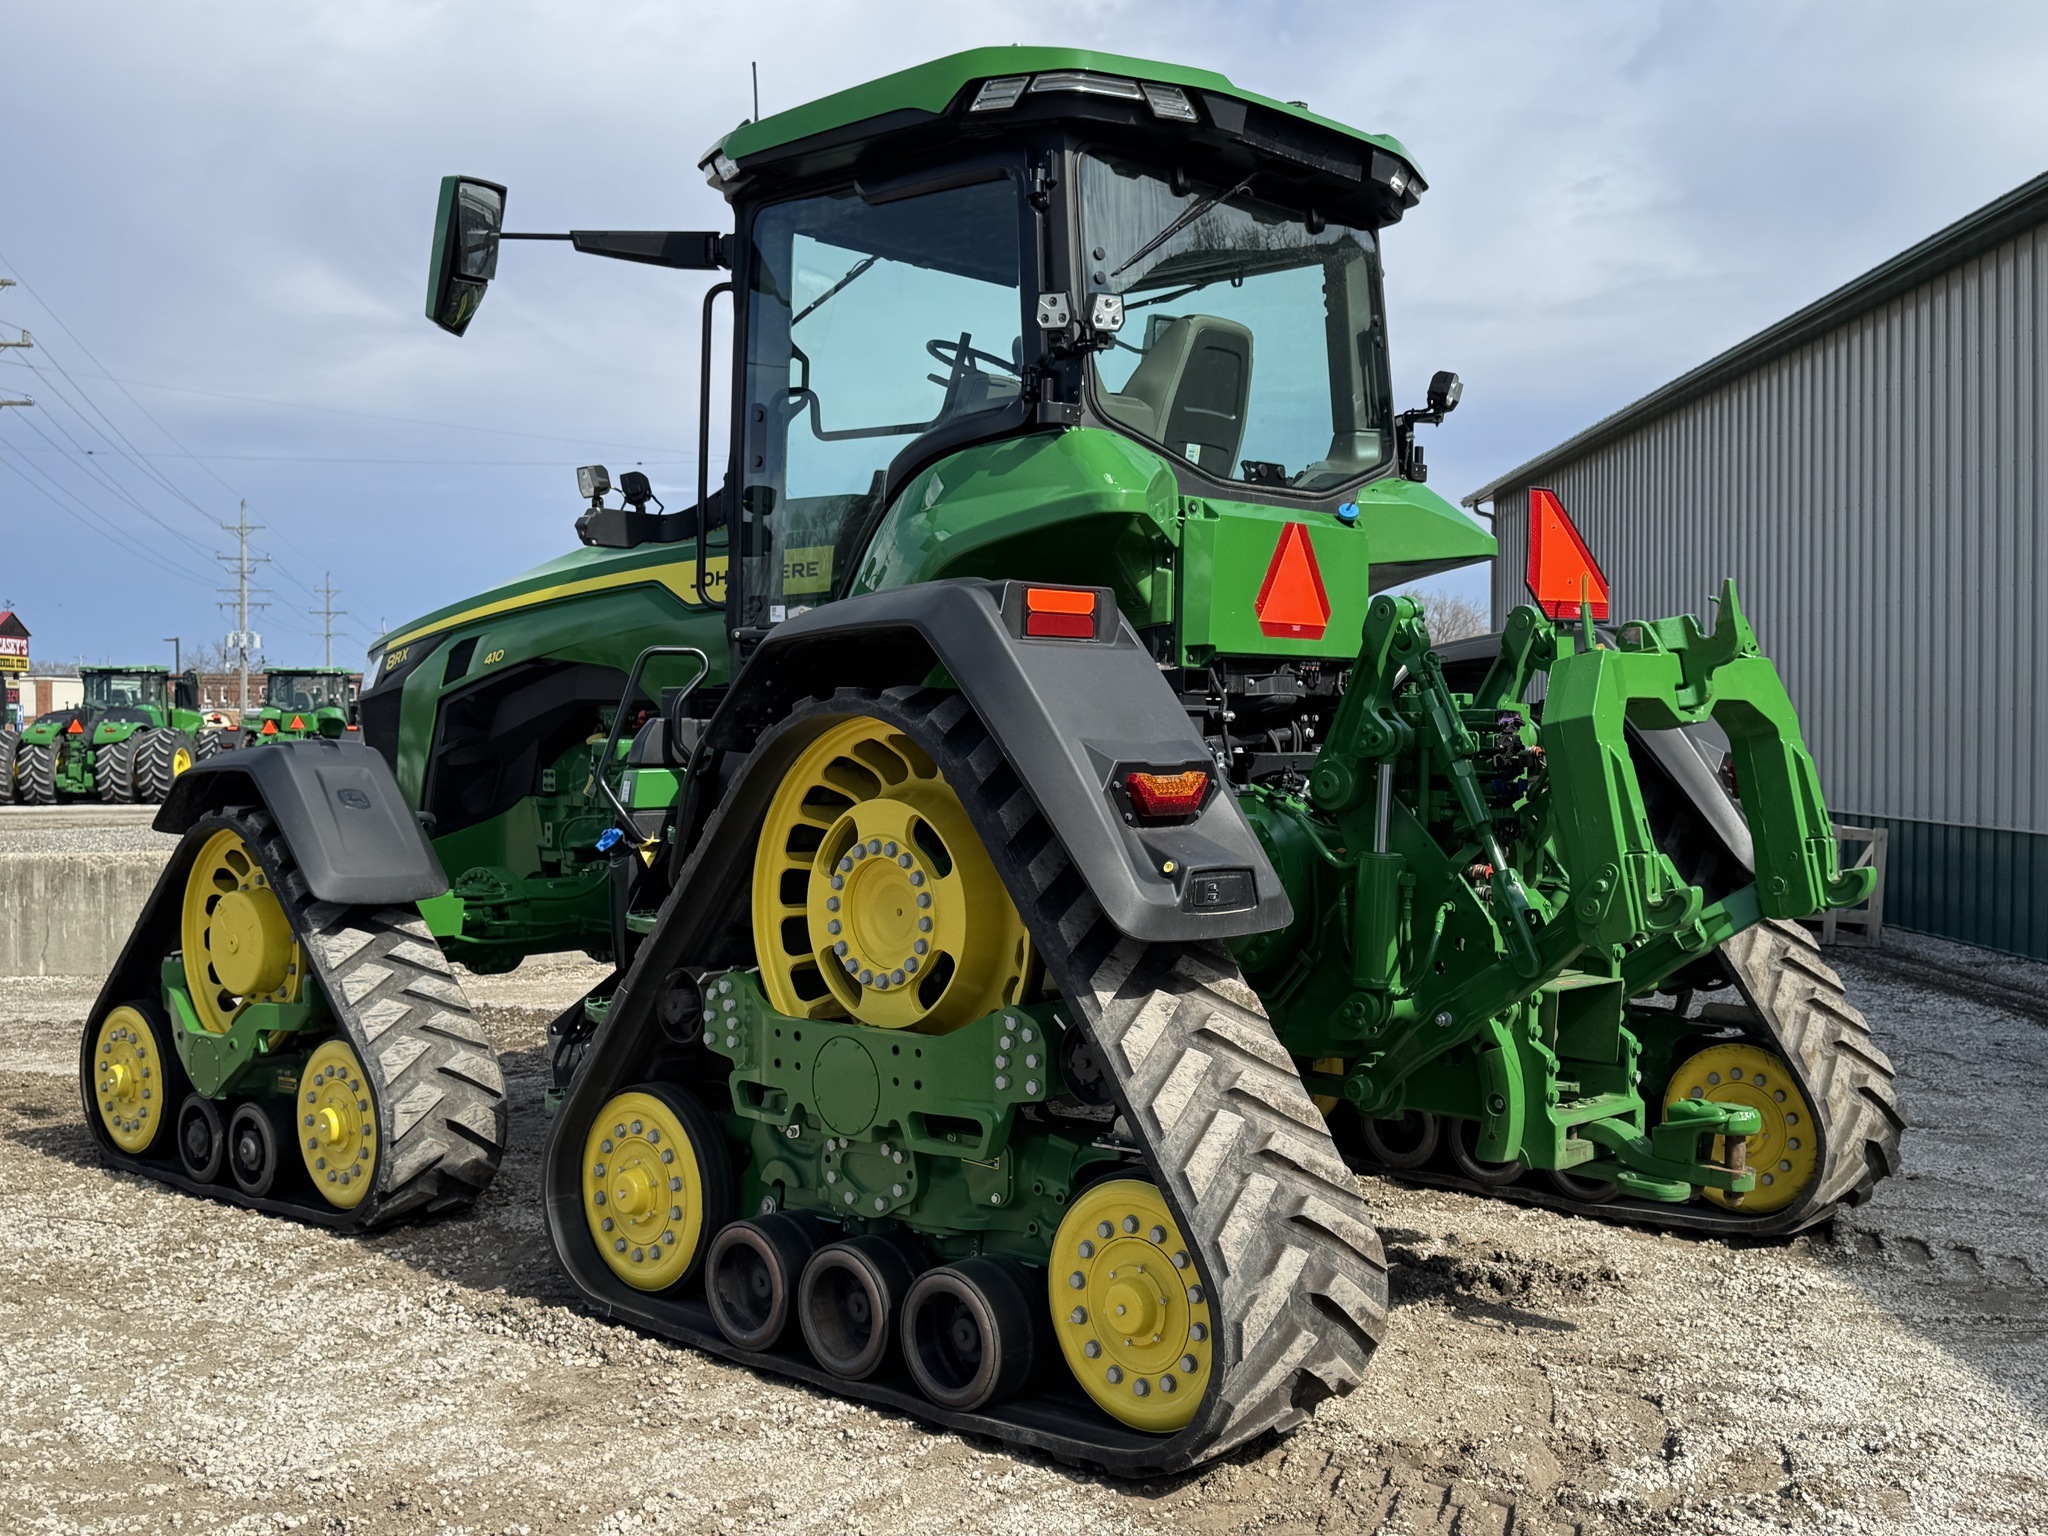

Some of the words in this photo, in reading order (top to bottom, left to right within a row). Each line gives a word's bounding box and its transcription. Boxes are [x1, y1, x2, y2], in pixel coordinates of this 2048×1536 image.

[783, 561, 819, 579] ERE
[386, 647, 409, 671] 8RX
[484, 649, 505, 665] 410
